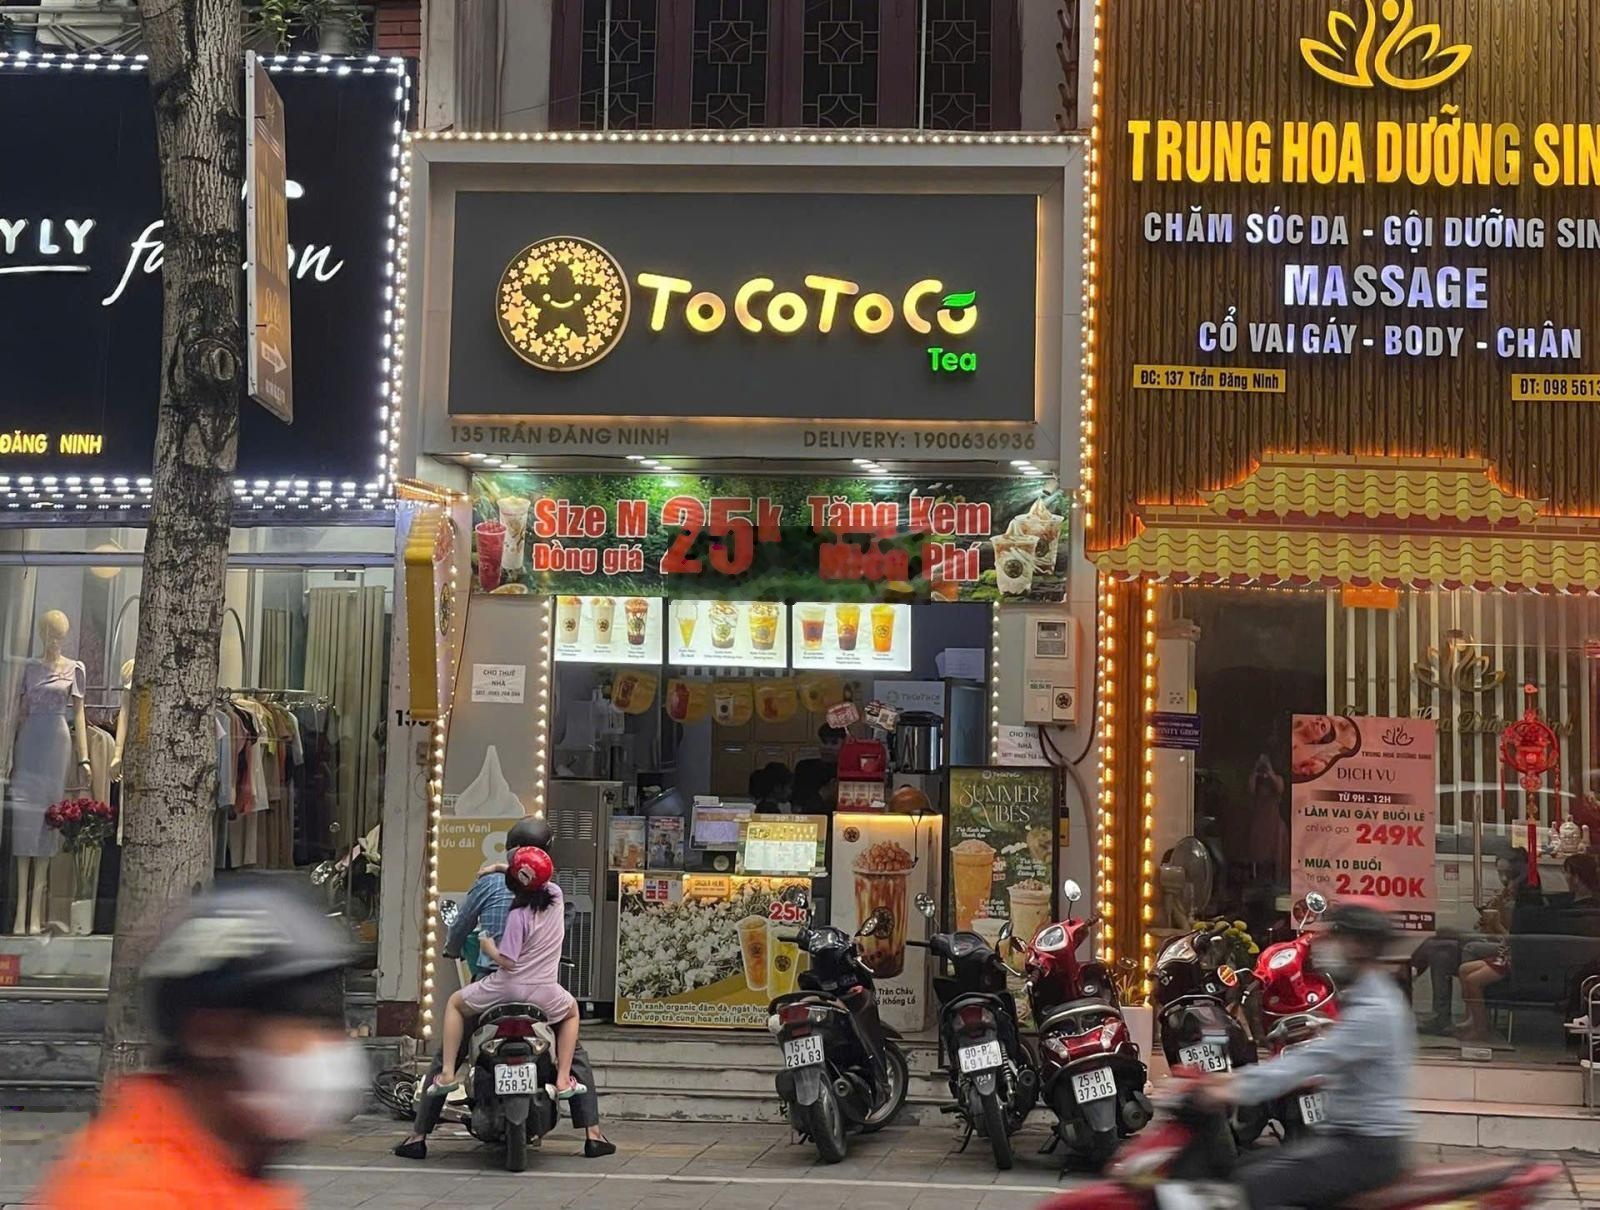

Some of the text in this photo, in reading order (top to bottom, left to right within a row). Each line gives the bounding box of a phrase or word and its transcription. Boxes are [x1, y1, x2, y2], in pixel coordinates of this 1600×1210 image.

[1128, 120, 1271, 184] TRUNG
[1282, 121, 1365, 184] HOA
[1377, 103, 1520, 187] DƯỠNG
[1144, 205, 1233, 244] CHĂM
[1246, 205, 1304, 244] SÓC
[1311, 215, 1349, 245] DA
[1384, 209, 1433, 253] GỘI
[1445, 207, 1544, 248] DƯỠNG
[1284, 264, 1488, 309] MASSAGE
[1199, 306, 1238, 352] CỔ
[1249, 322, 1295, 353] VAI
[1302, 317, 1358, 354] GÁY
[1385, 325, 1464, 357] BODY
[1497, 320, 1581, 358] CHÂN
[928, 347, 977, 373] Tea
[1141, 370, 1161, 385] ĐC:
[1165, 370, 1184, 385] 137
[1219, 371, 1248, 390] Đăng
[1544, 379, 1567, 395] 098
[451, 420, 670, 445] 135 TRẦN ĐĂNG NINH
[803, 431, 1036, 450] DELIVERY: 1900636936
[60, 433, 103, 455] NINH
[534, 498, 648, 538] Size M
[909, 496, 992, 536] Kem
[660, 495, 784, 575] 25k
[532, 540, 644, 574] Đồng giá
[1337, 767, 1396, 784] DỊCH VỤ
[1338, 791, 1350, 802] TỪ
[1352, 793, 1365, 803] 9H
[1373, 794, 1391, 804] 12H
[1304, 805, 1328, 817] LÀM
[1332, 808, 1351, 818] VAI
[1354, 806, 1379, 819] GÁY
[441, 822, 491, 833] Kem Vani
[1356, 823, 1425, 847] 249K
[1304, 855, 1382, 871] MUA 10 BUỔI
[1336, 873, 1426, 898] 2.200K
[769, 901, 806, 921] 25k
[630, 1002, 642, 1010] Trà
[645, 1002, 664, 1010] xanh
[666, 1003, 696, 1013] organic
[662, 1012, 673, 1021] trà
[698, 1013, 712, 1022] hoa
[790, 1038, 815, 1053] 15-C1
[1186, 1044, 1215, 1061] 36-B4
[499, 1079, 533, 1092] 258.54
[1078, 1070, 1106, 1087] 25-B1
[1078, 1082, 1113, 1101] 373.05
